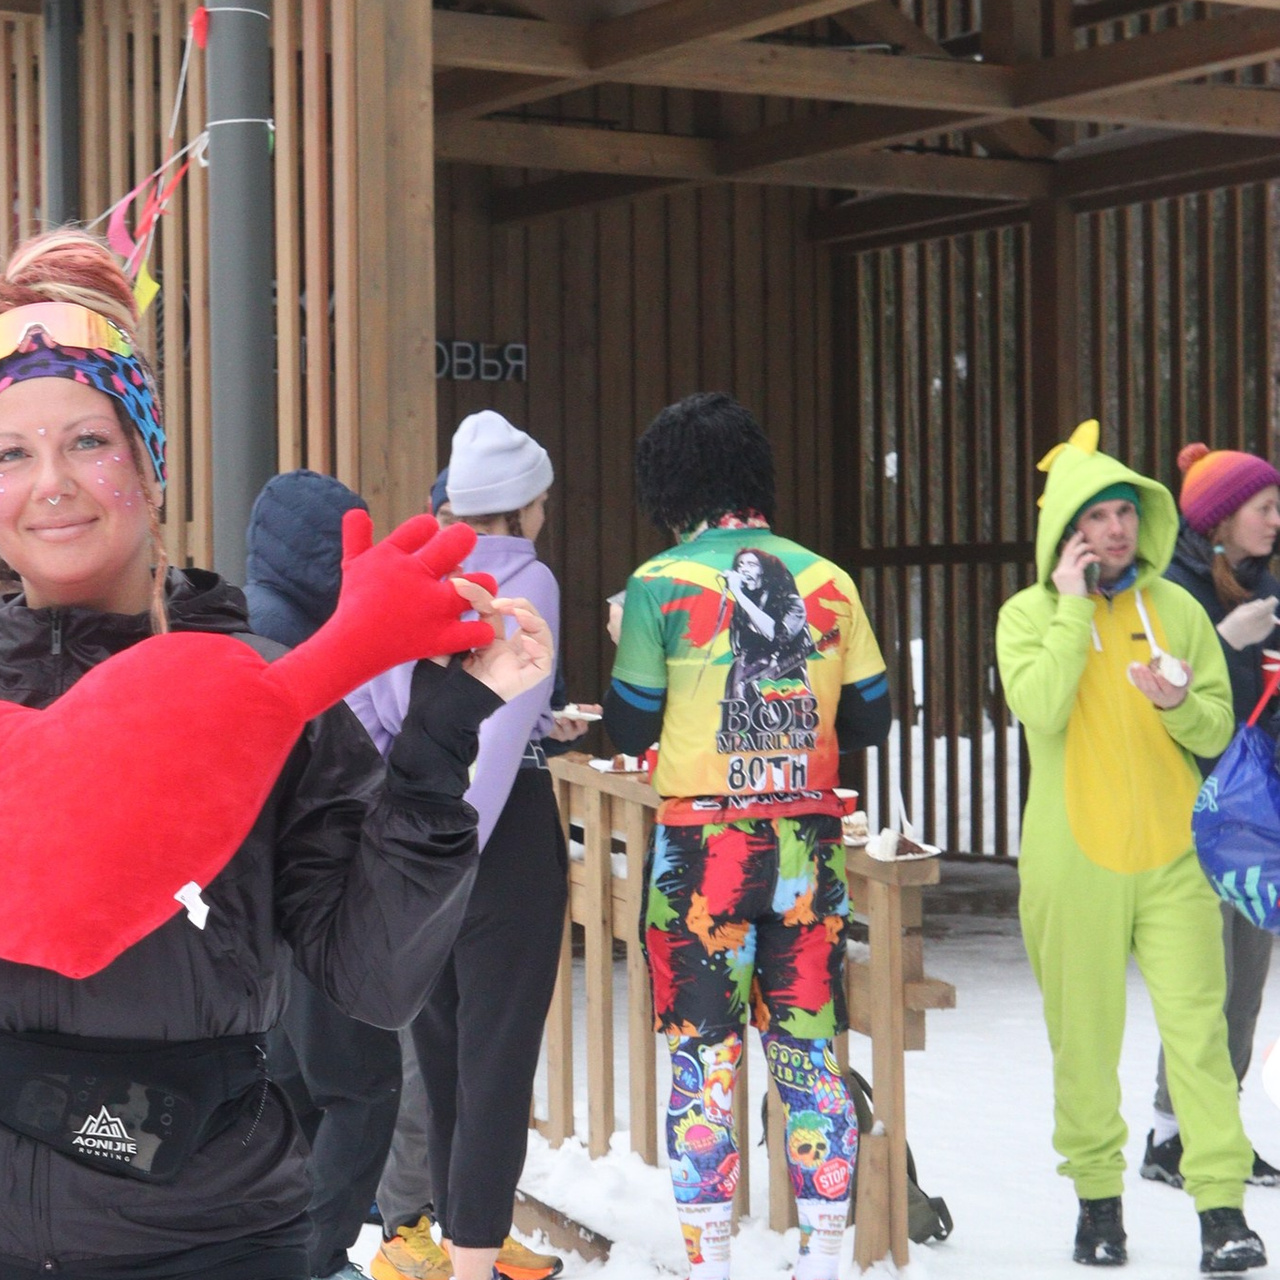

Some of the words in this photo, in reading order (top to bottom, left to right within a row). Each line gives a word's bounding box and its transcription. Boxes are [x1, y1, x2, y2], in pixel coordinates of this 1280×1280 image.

[718, 696, 820, 735] BOB
[717, 730, 818, 753] MARLEY
[727, 753, 808, 792] 80TH
[72, 1136, 138, 1155] AONIJIE
[78, 1146, 130, 1162] RUNNING
[819, 1166, 846, 1189] STOP
